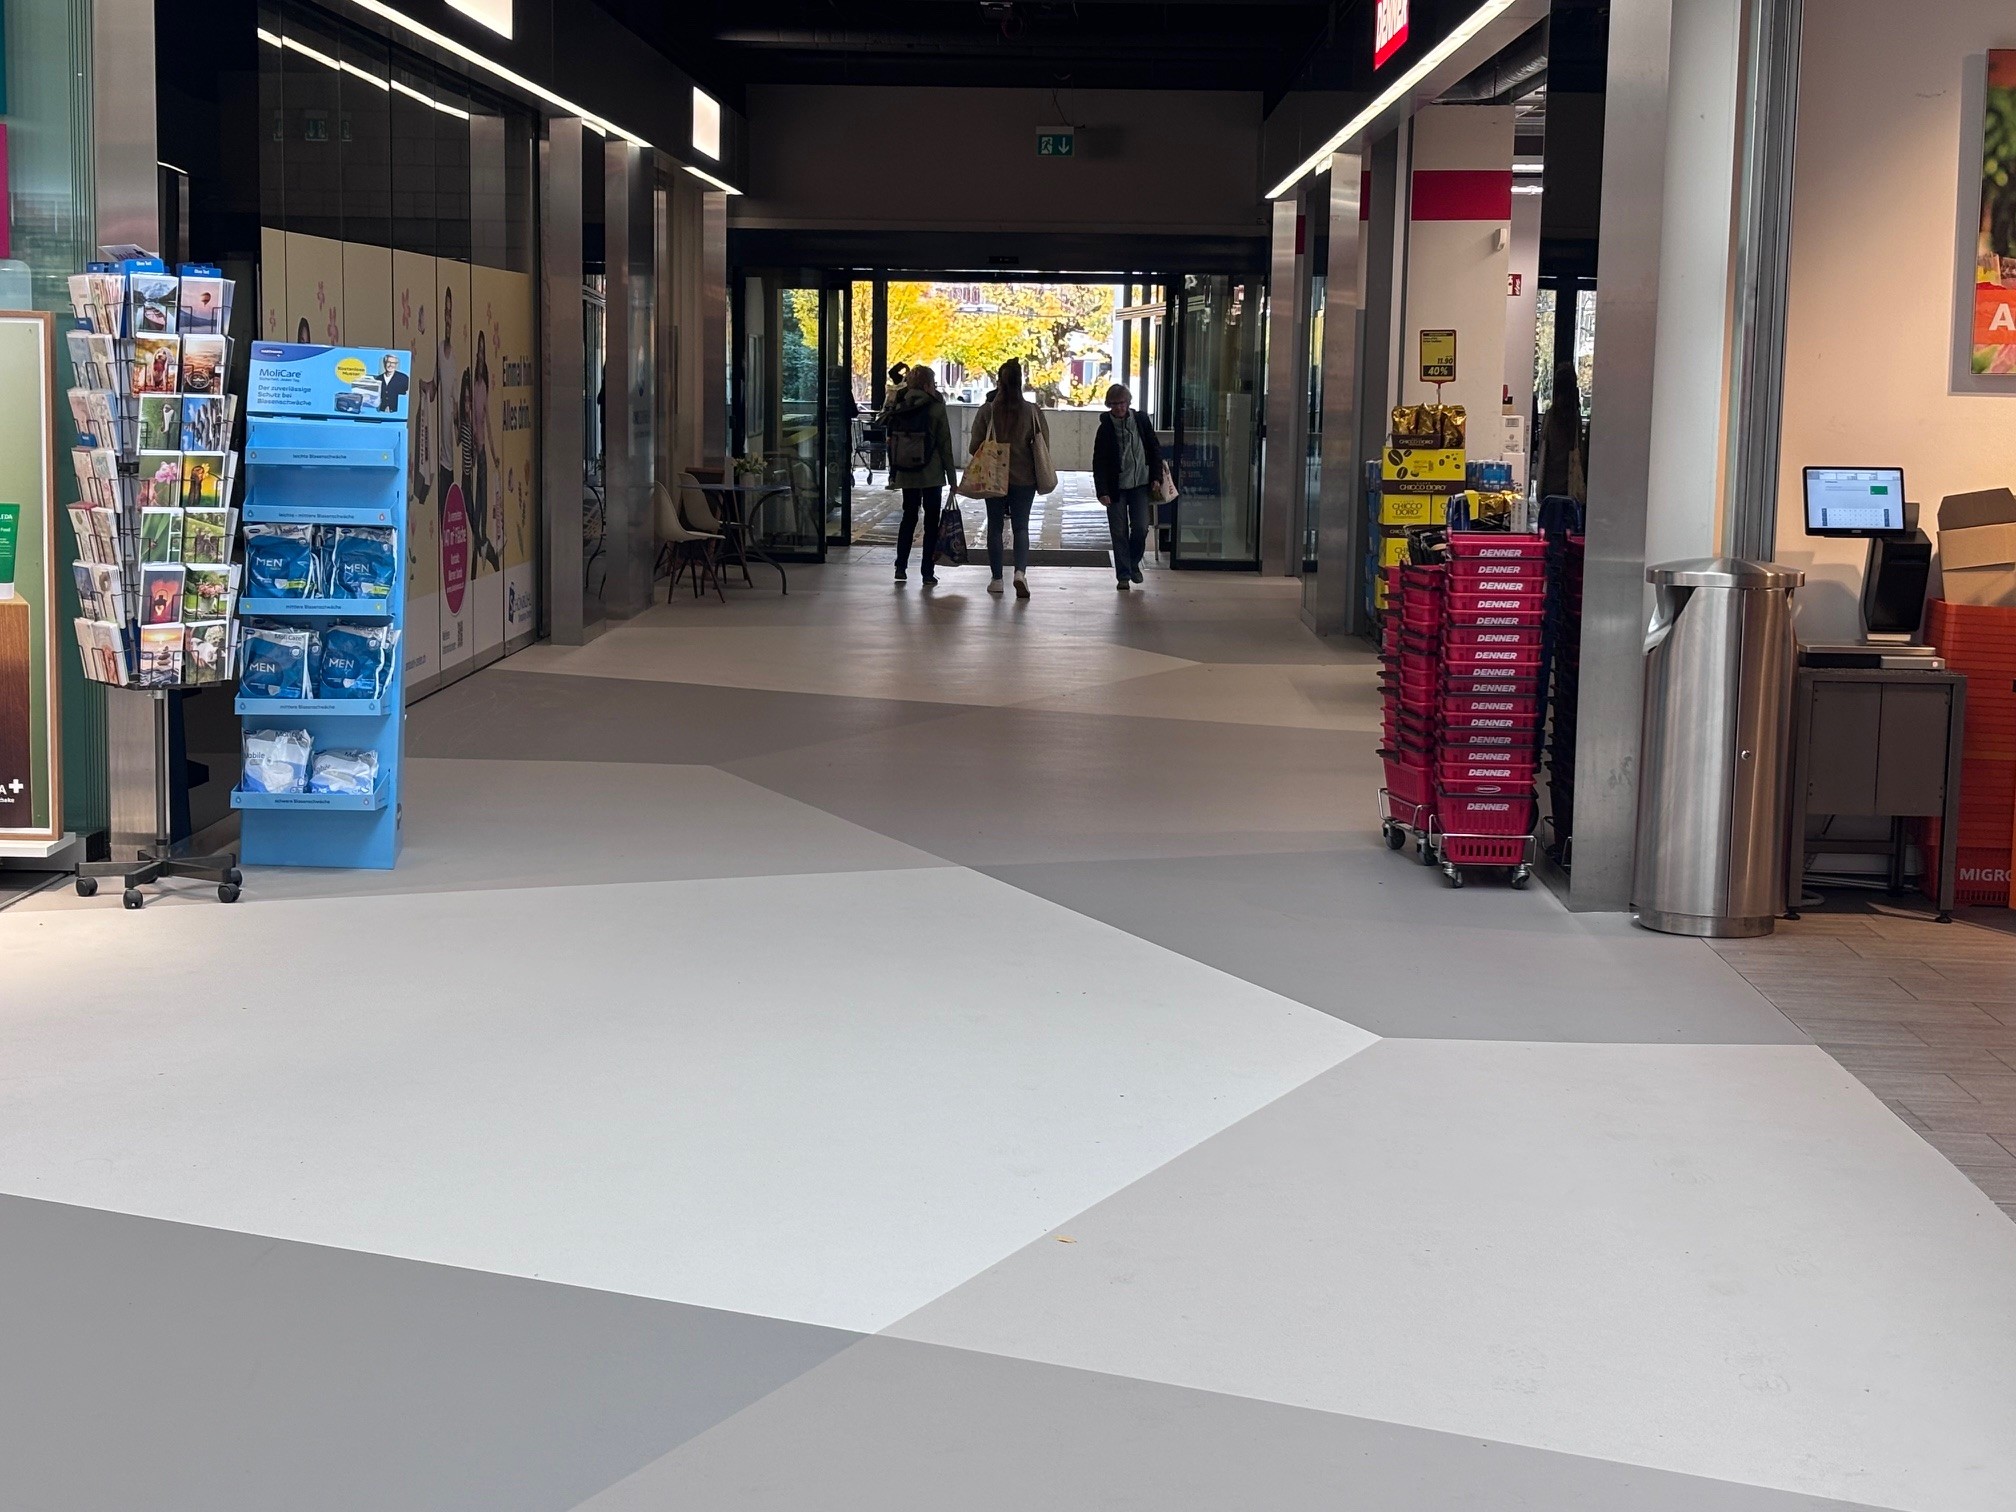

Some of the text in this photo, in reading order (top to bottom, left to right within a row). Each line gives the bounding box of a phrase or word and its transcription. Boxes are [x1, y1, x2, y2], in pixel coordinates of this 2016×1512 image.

[259, 368, 302, 379] MoliCare
[257, 398, 312, 406] Blasenschwäche
[1478, 549, 1522, 557] DENNER
[255, 557, 283, 567] MEN
[344, 563, 370, 573] MEN
[1477, 565, 1521, 574] DENNER
[1478, 582, 1523, 590] DENNER
[1477, 600, 1520, 609] DENNER
[1476, 617, 1519, 625] DENNER
[1477, 634, 1520, 642] DENNER
[1474, 651, 1517, 659] DENNER
[328, 657, 355, 669] MEN
[249, 662, 276, 673] MEN
[1472, 668, 1515, 676] DENNER
[1472, 684, 1515, 692] DENNER
[1470, 702, 1513, 710] DENNER
[1470, 718, 1513, 727] DENNER
[1469, 736, 1511, 744] DENNER
[1468, 752, 1511, 760] DENNER
[1468, 768, 1510, 777] DENNER
[1466, 802, 1509, 811] DENNER
